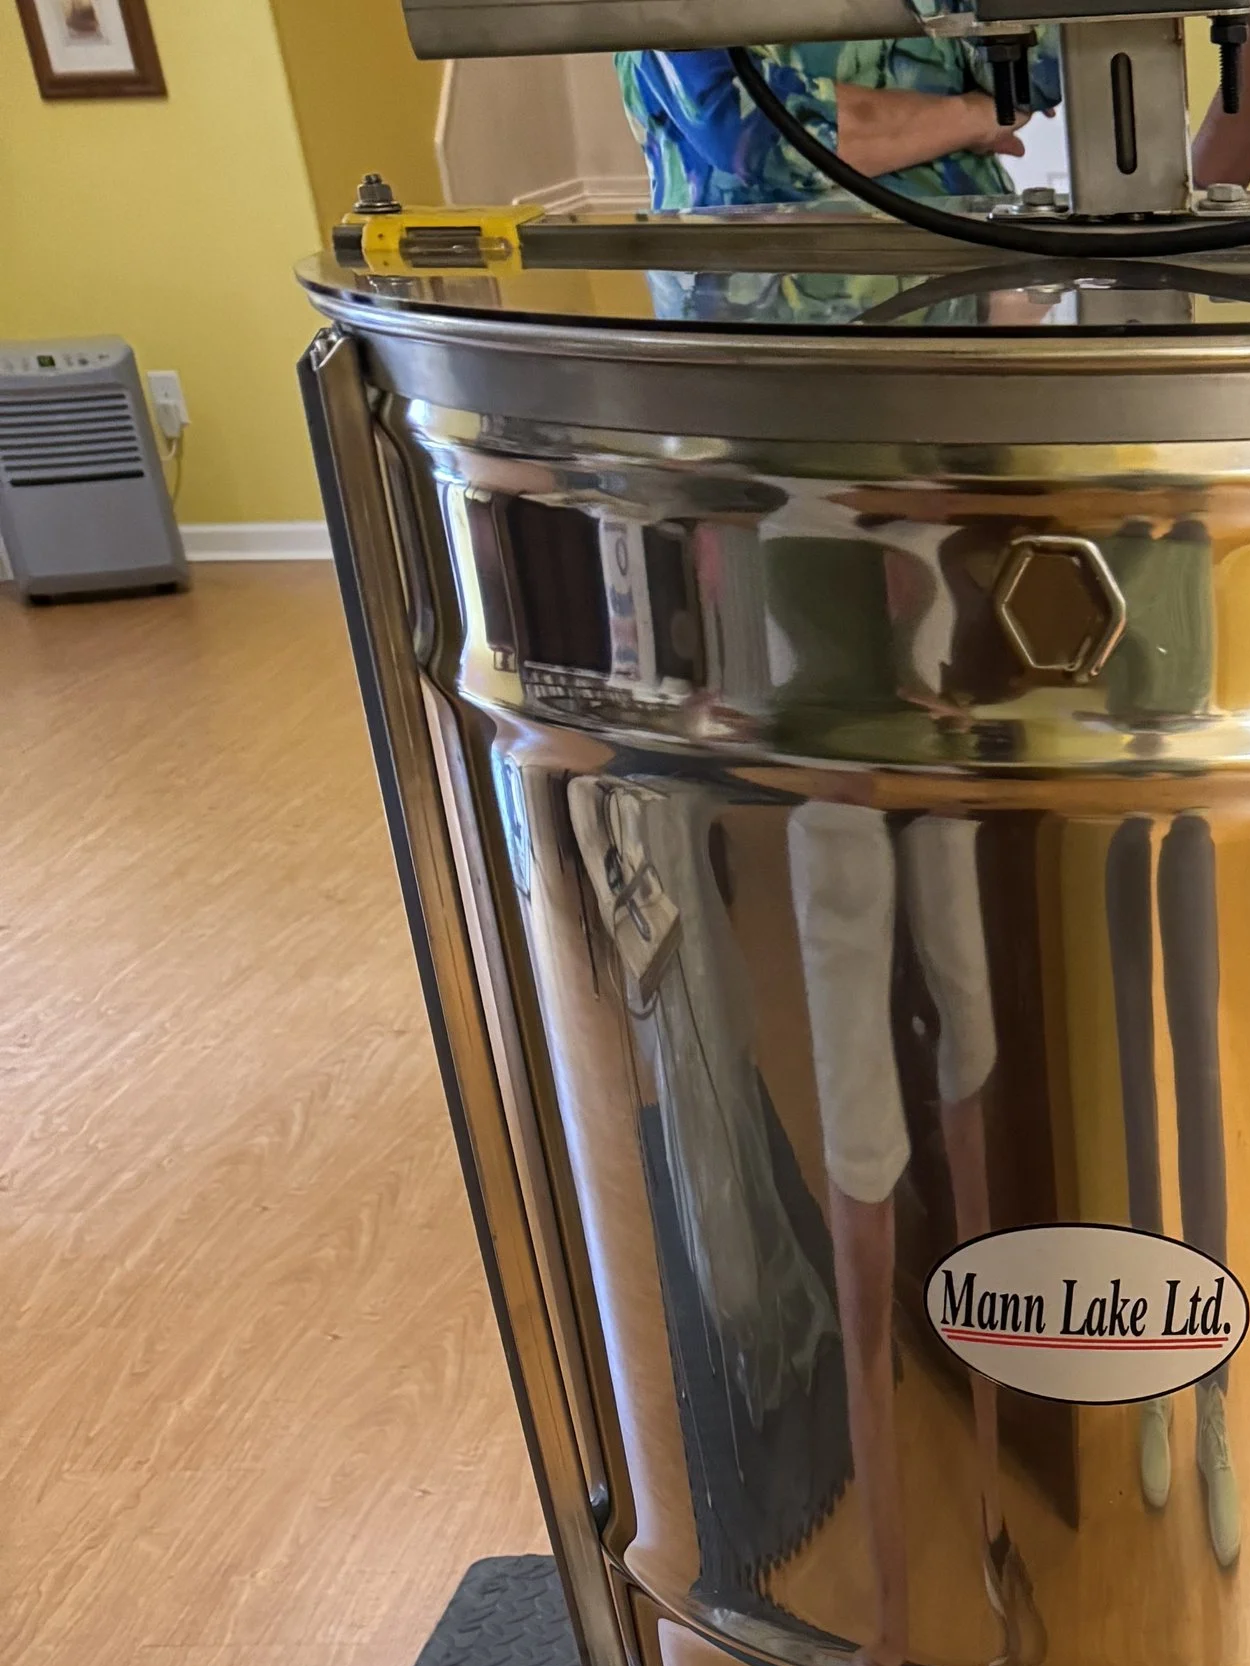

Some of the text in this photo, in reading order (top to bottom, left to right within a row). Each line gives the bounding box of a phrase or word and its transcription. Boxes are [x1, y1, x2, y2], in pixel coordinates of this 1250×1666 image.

[940, 1269, 1231, 1337] Mann Lake Ltd.
